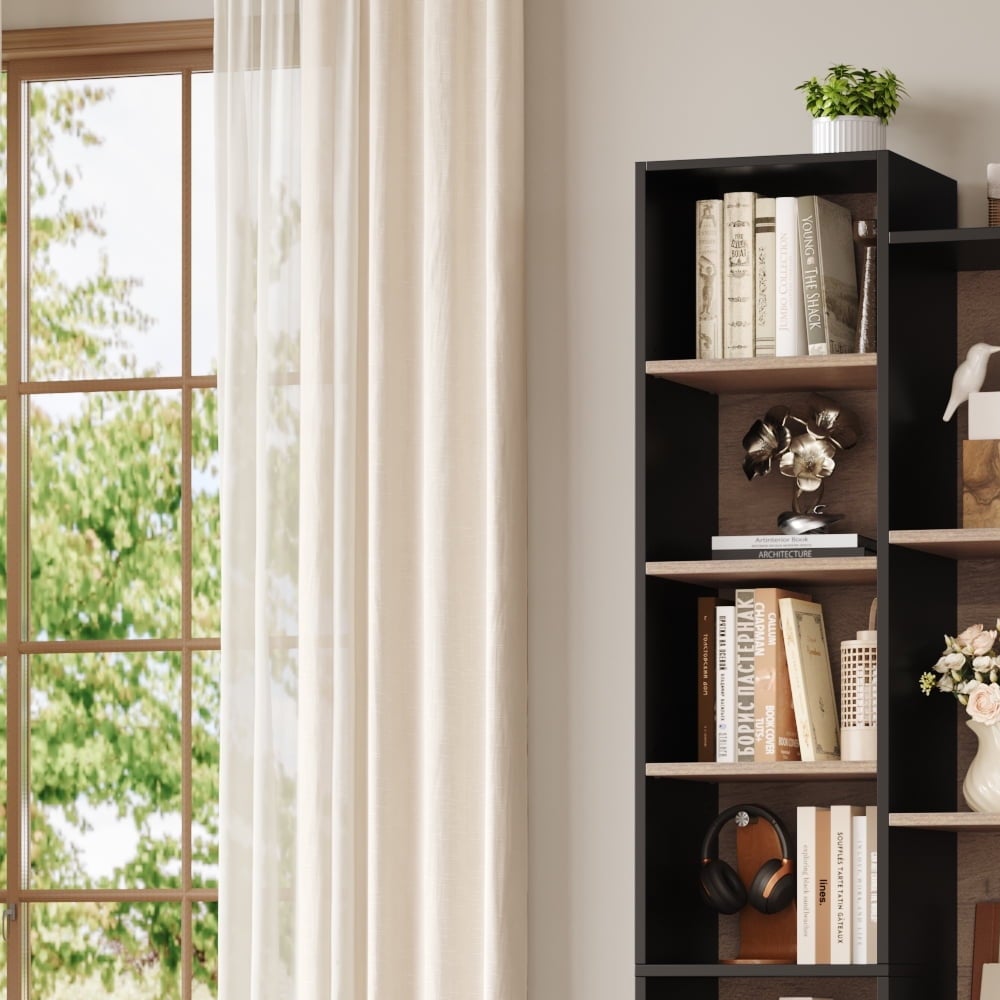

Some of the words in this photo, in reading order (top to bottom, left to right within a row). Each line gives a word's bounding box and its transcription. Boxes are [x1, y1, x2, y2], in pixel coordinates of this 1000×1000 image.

[801, 215, 815, 256] YOUNG
[804, 267, 819, 292] THE
[806, 293, 821, 330] SHACK
[758, 550, 812, 559] ARCHITECTURE
[738, 597, 754, 695] ПАСТЕРНАК
[754, 602, 766, 656] CHAPMAN
[768, 612, 776, 646] CALLUM
[738, 702, 754, 756] БОРИС
[765, 705, 776, 729] BOOK
[765, 729, 776, 755] COVER
[819, 879, 828, 906] lines.
